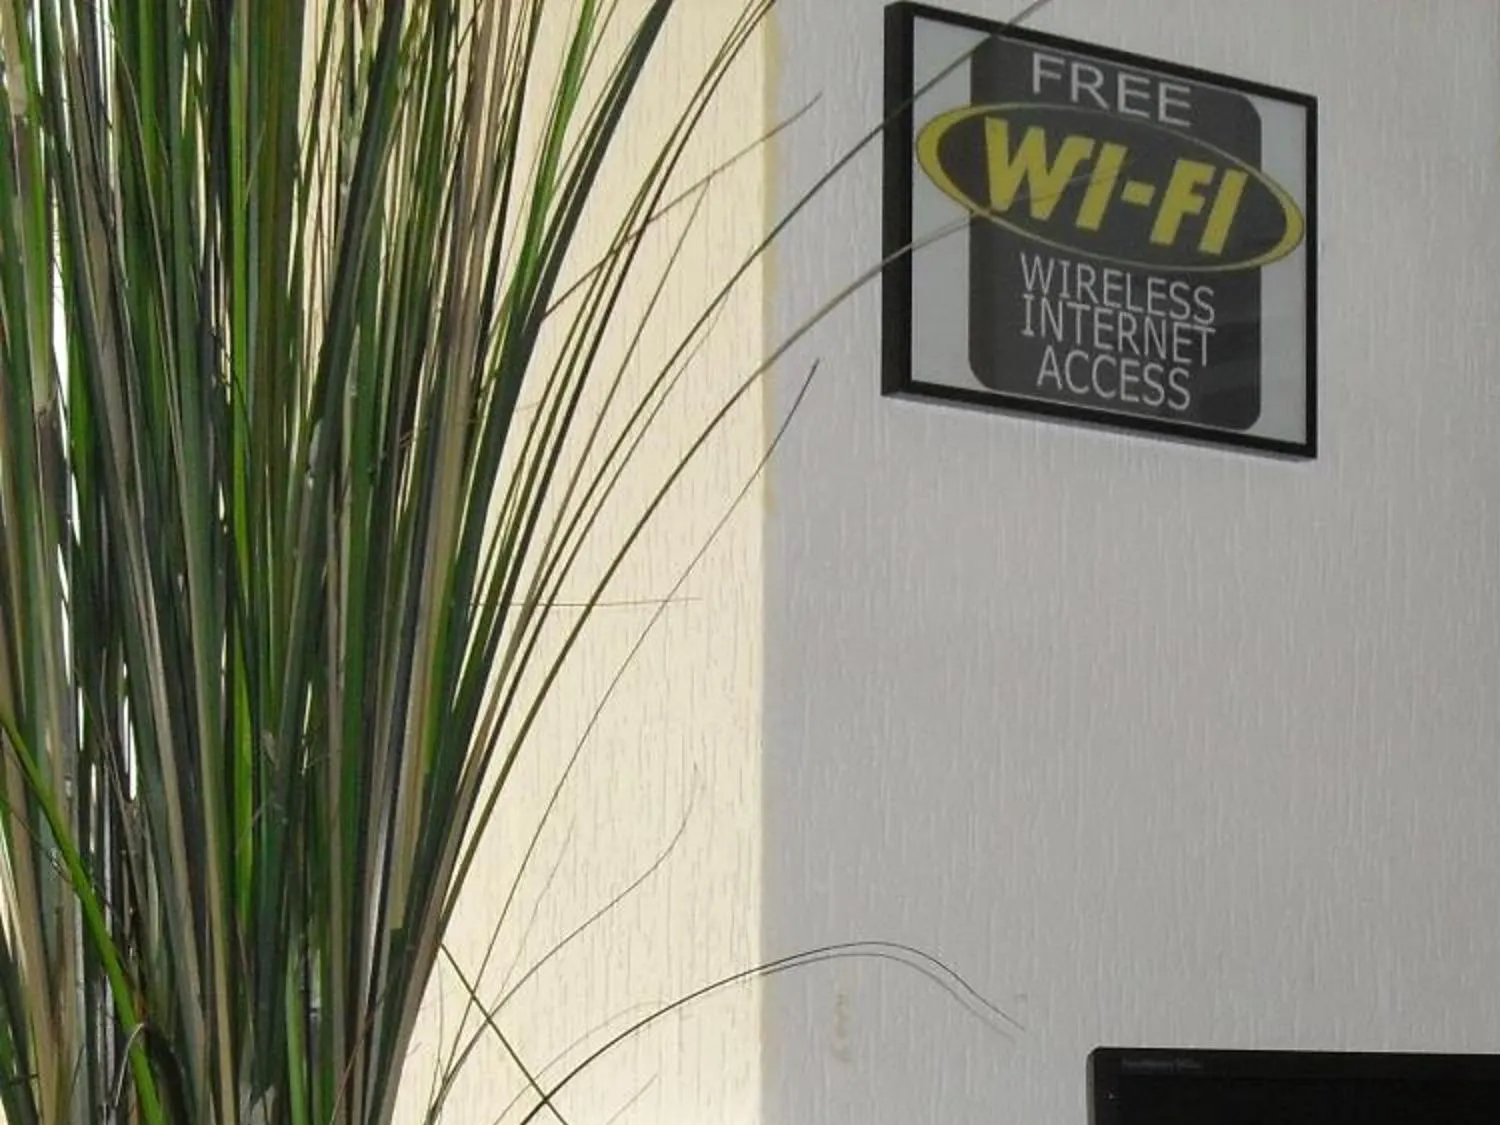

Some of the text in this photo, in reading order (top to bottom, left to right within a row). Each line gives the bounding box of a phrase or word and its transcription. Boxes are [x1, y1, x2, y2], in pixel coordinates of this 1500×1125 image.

[1032, 52, 1192, 128] FREE
[1020, 252, 1216, 326] WIRELESS
[1021, 293, 1217, 367] INTERNET
[1036, 345, 1192, 411] ACCESS
